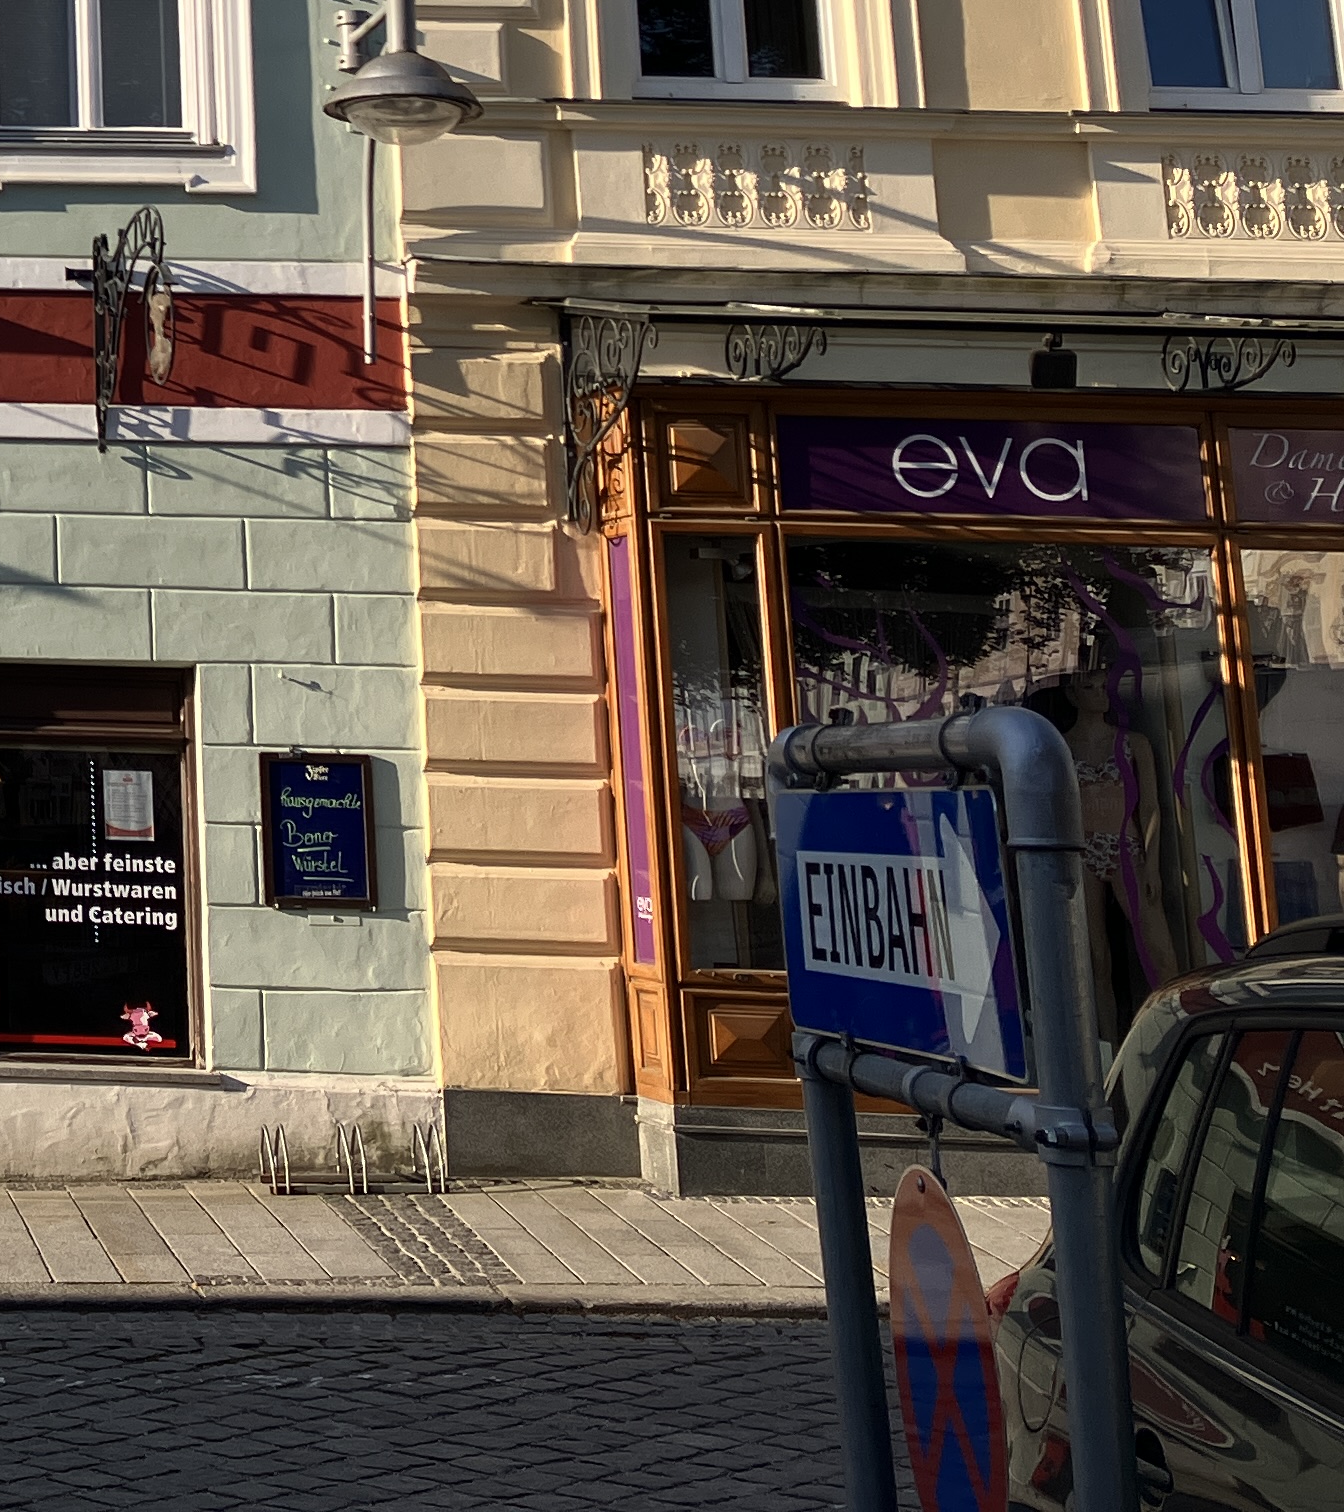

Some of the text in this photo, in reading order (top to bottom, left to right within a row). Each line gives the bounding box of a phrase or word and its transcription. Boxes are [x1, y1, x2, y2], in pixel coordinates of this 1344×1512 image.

[890, 432, 1089, 503] eva
[51, 852, 99, 872] aber
[103, 853, 176, 874] feinste
[51, 879, 178, 901] Wurstwaren
[44, 904, 178, 930] und Catering
[804, 861, 956, 981] EINBAHN
